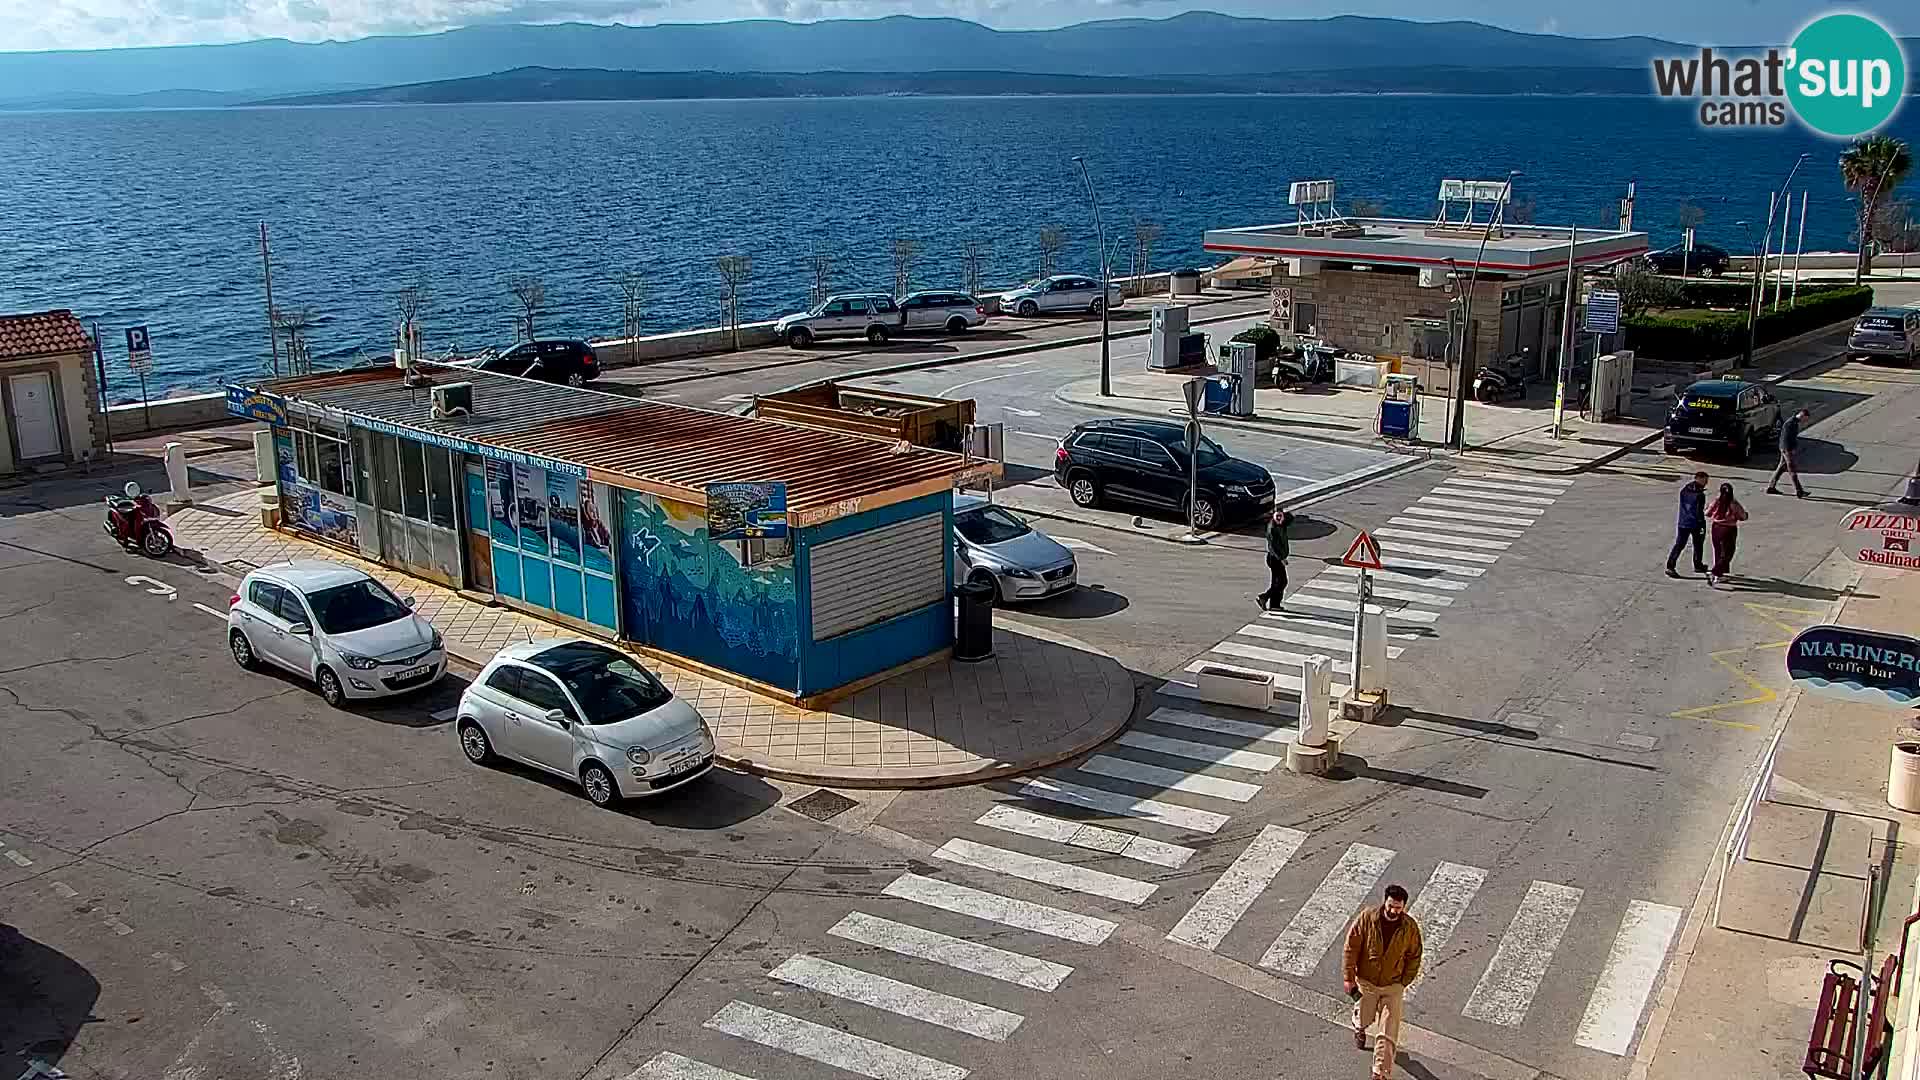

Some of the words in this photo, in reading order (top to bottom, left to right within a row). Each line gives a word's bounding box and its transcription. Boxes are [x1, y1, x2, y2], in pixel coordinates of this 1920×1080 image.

[131, 330, 144, 349] P
[397, 425, 436, 443] AUTOBUSNA
[437, 435, 468, 451] POSTAJA
[479, 445, 494, 457] BUS
[494, 448, 526, 465] STATION
[527, 456, 554, 473] TICKET
[555, 463, 583, 476] OFFICE
[1848, 514, 1920, 532] PIZZE
[1828, 661, 1865, 673] caffe
[1869, 665, 1896, 679] bar
